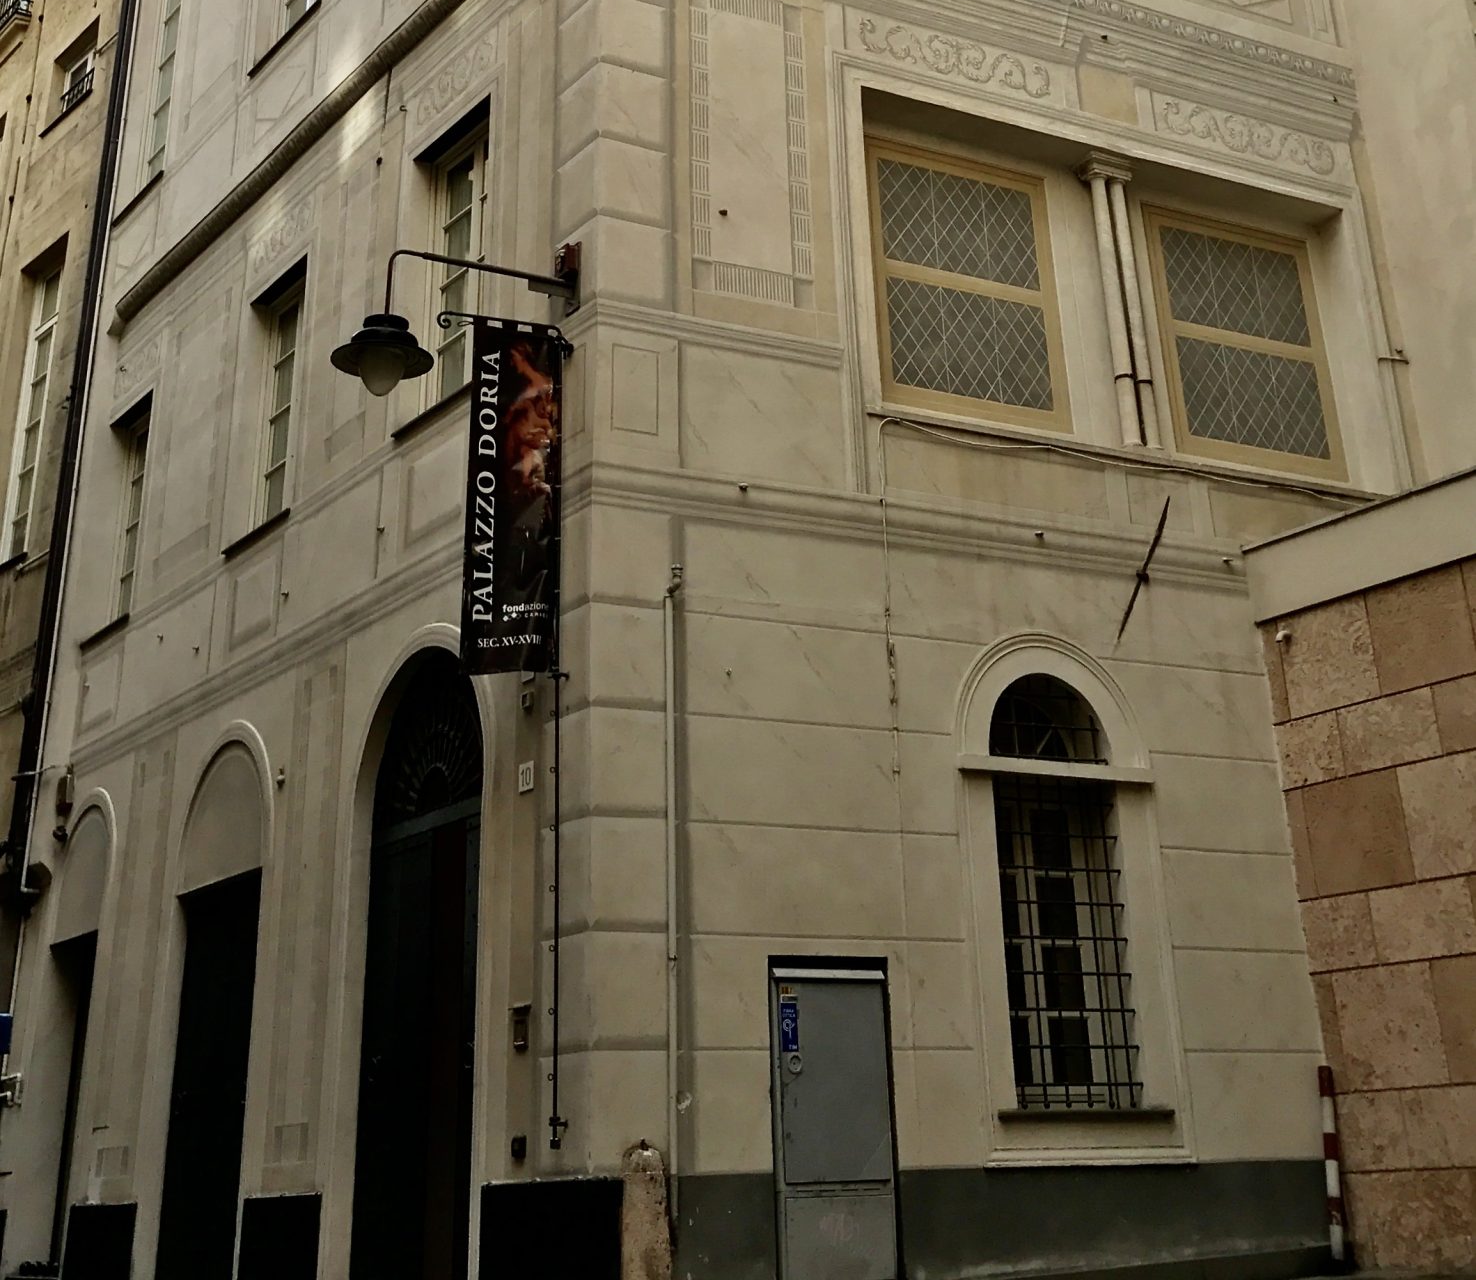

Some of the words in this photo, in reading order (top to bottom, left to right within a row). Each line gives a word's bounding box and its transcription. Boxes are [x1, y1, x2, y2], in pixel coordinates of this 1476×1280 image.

[478, 350, 501, 458] DORIA
[472, 471, 496, 623] PALAZZO
[477, 637, 500, 648] SEC.
[520, 766, 532, 788] 10
